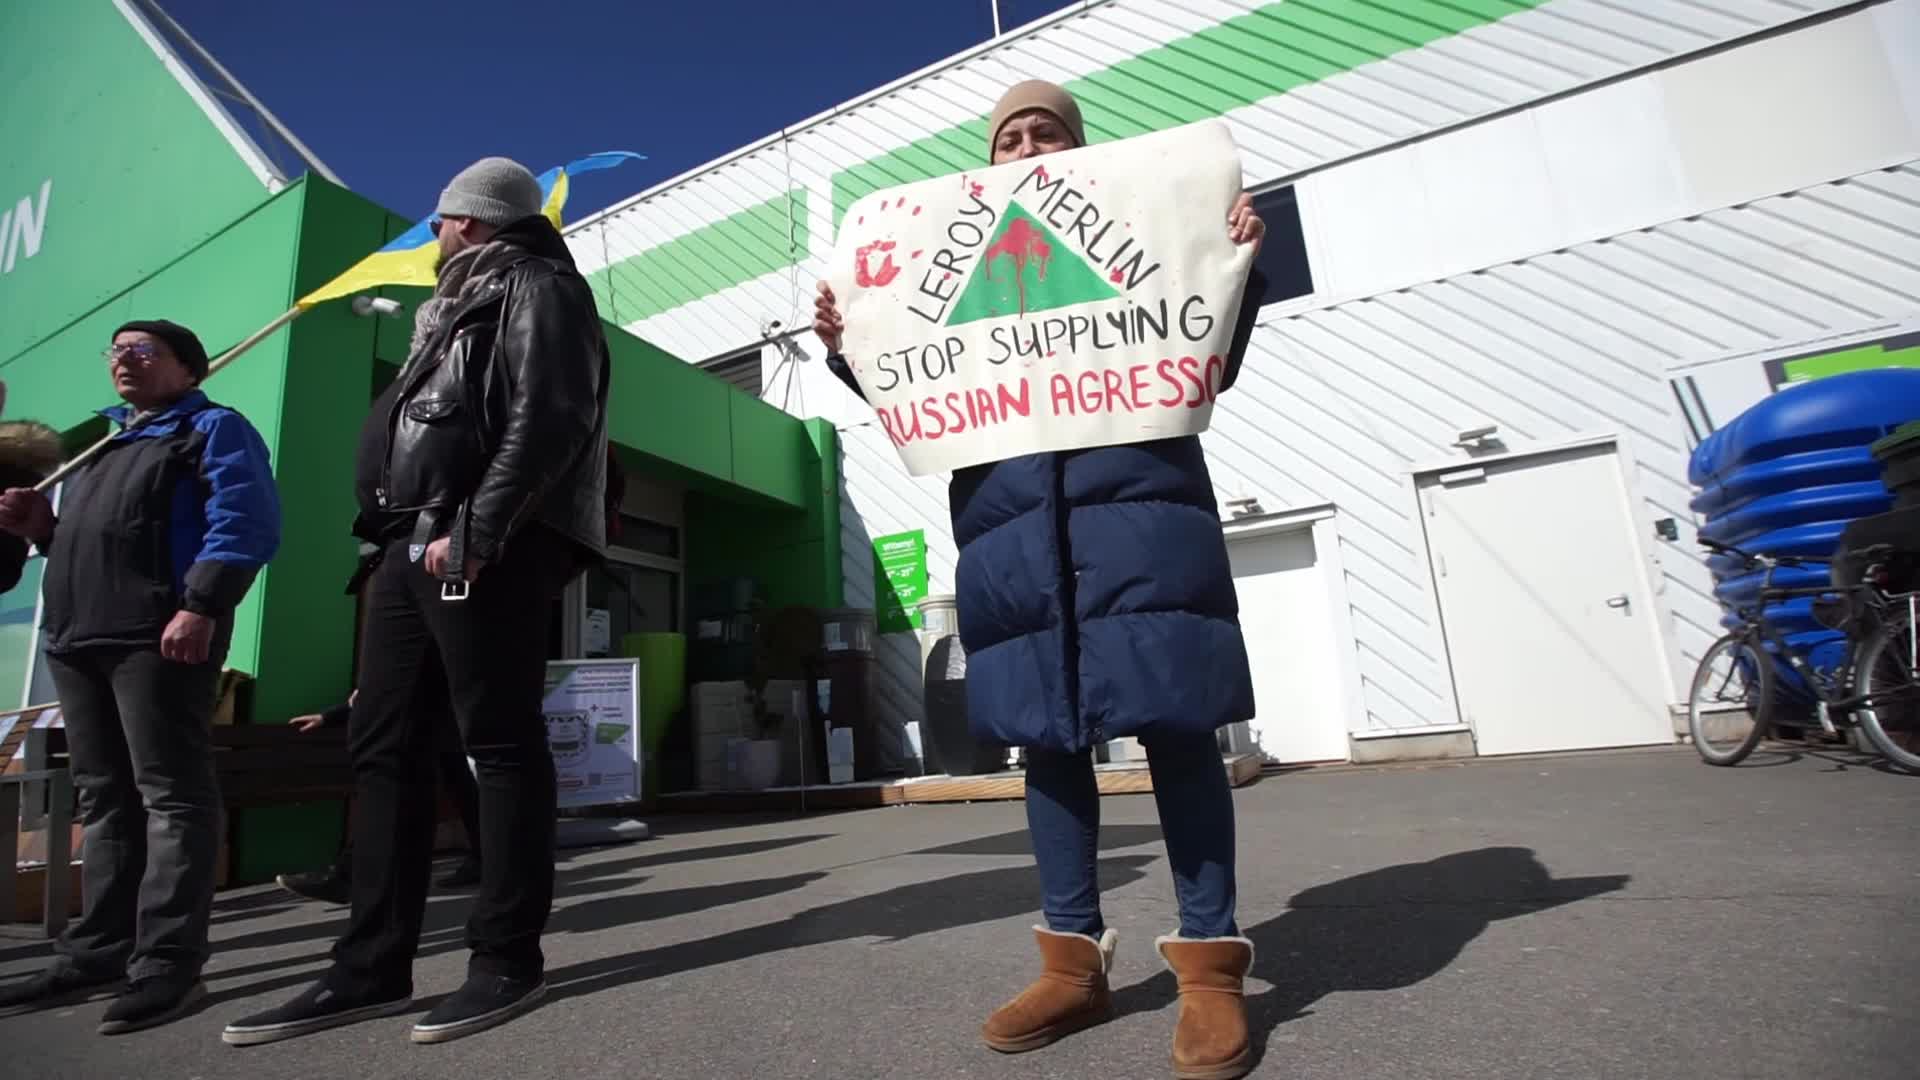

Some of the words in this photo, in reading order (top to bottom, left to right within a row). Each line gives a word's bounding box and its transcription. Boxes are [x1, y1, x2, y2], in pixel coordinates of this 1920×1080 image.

[907, 193, 996, 324] LEROY
[1012, 164, 1161, 290] MERLIN
[876, 337, 965, 391] STOP
[876, 377, 1031, 447] RUSSIAN
